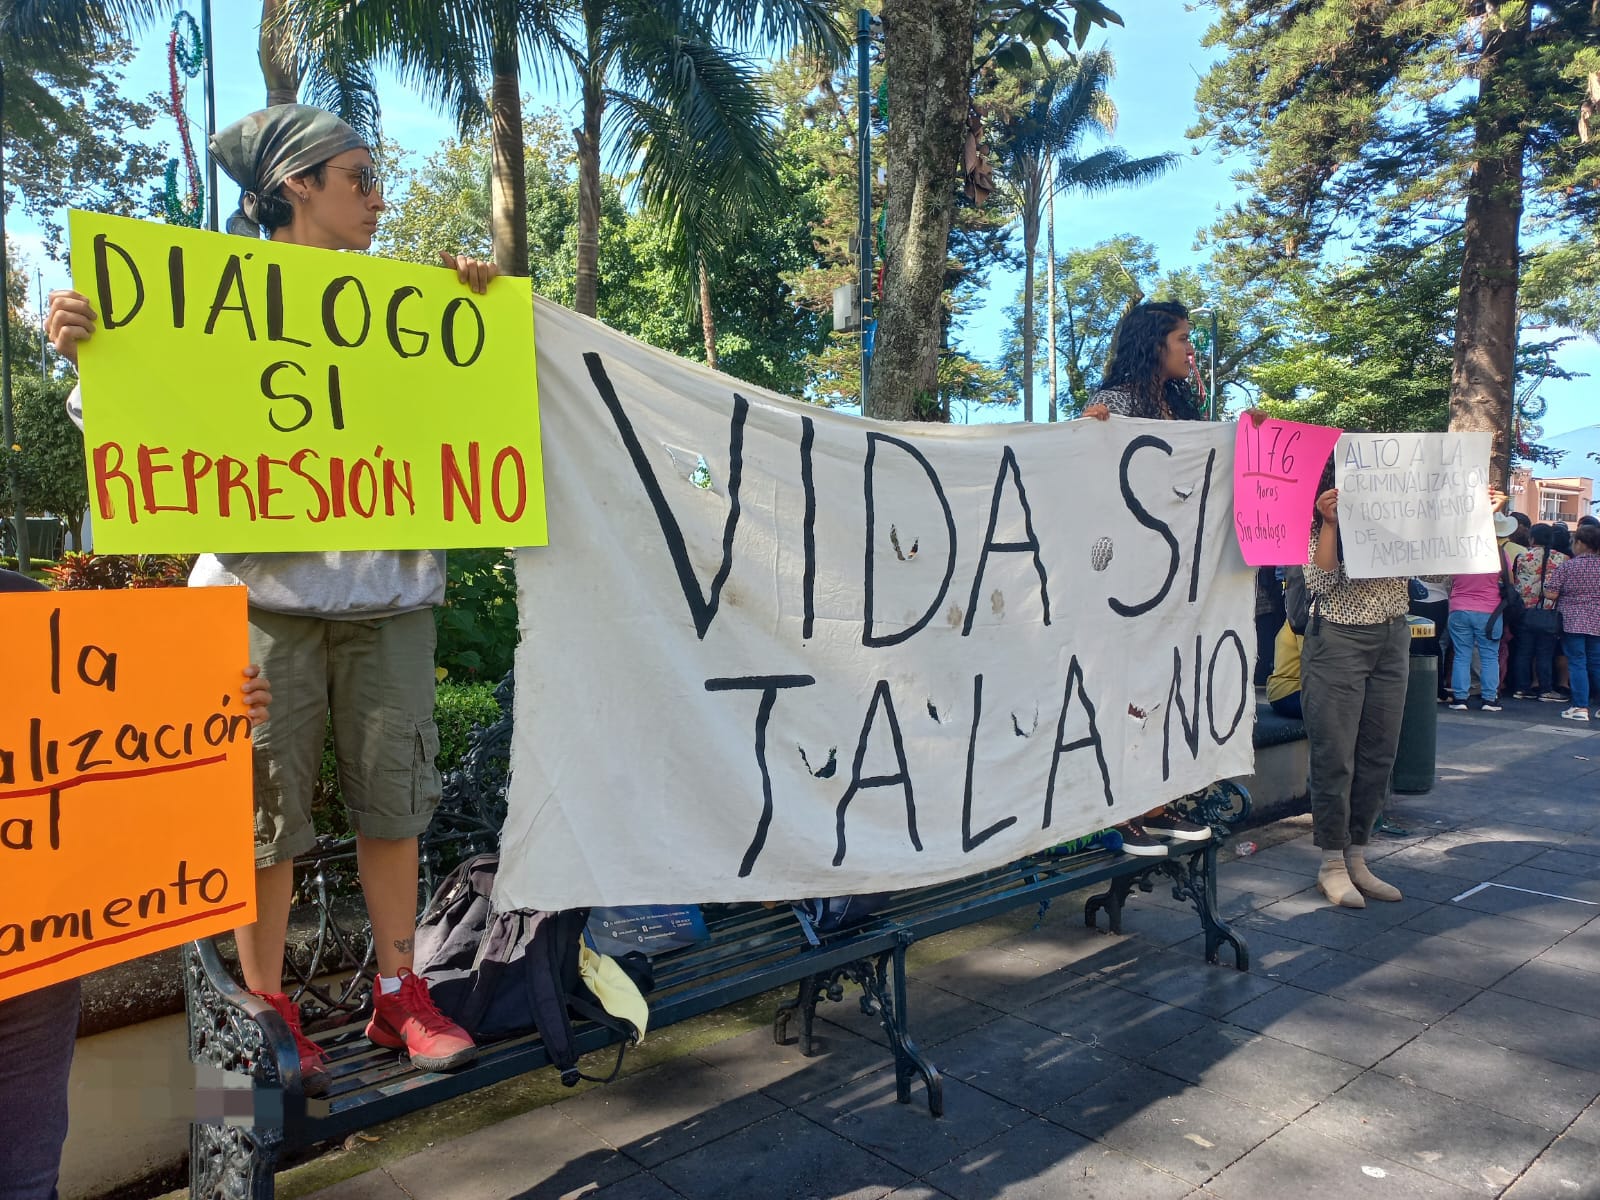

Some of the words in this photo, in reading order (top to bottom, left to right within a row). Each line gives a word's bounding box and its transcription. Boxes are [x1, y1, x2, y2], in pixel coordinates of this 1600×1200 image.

[94, 233, 485, 367] DIÁLOGO
[260, 360, 345, 432] SI
[93, 444, 416, 524] REPRESIÓN
[441, 440, 527, 524] NO
[1245, 423, 1301, 474] 1176
[1344, 438, 1400, 470] ALTO
[1409, 439, 1425, 467] A
[1440, 439, 1463, 467] LA
[582, 351, 1052, 648] VIDA
[1107, 434, 1216, 618] SI
[1345, 503, 1354, 520] Y
[1361, 495, 1475, 521] HOSTIGAMIENTO
[1354, 528, 1378, 545] DE
[49, 608, 118, 694] la
[704, 654, 1114, 878] TALA
[1163, 629, 1248, 782] NO
